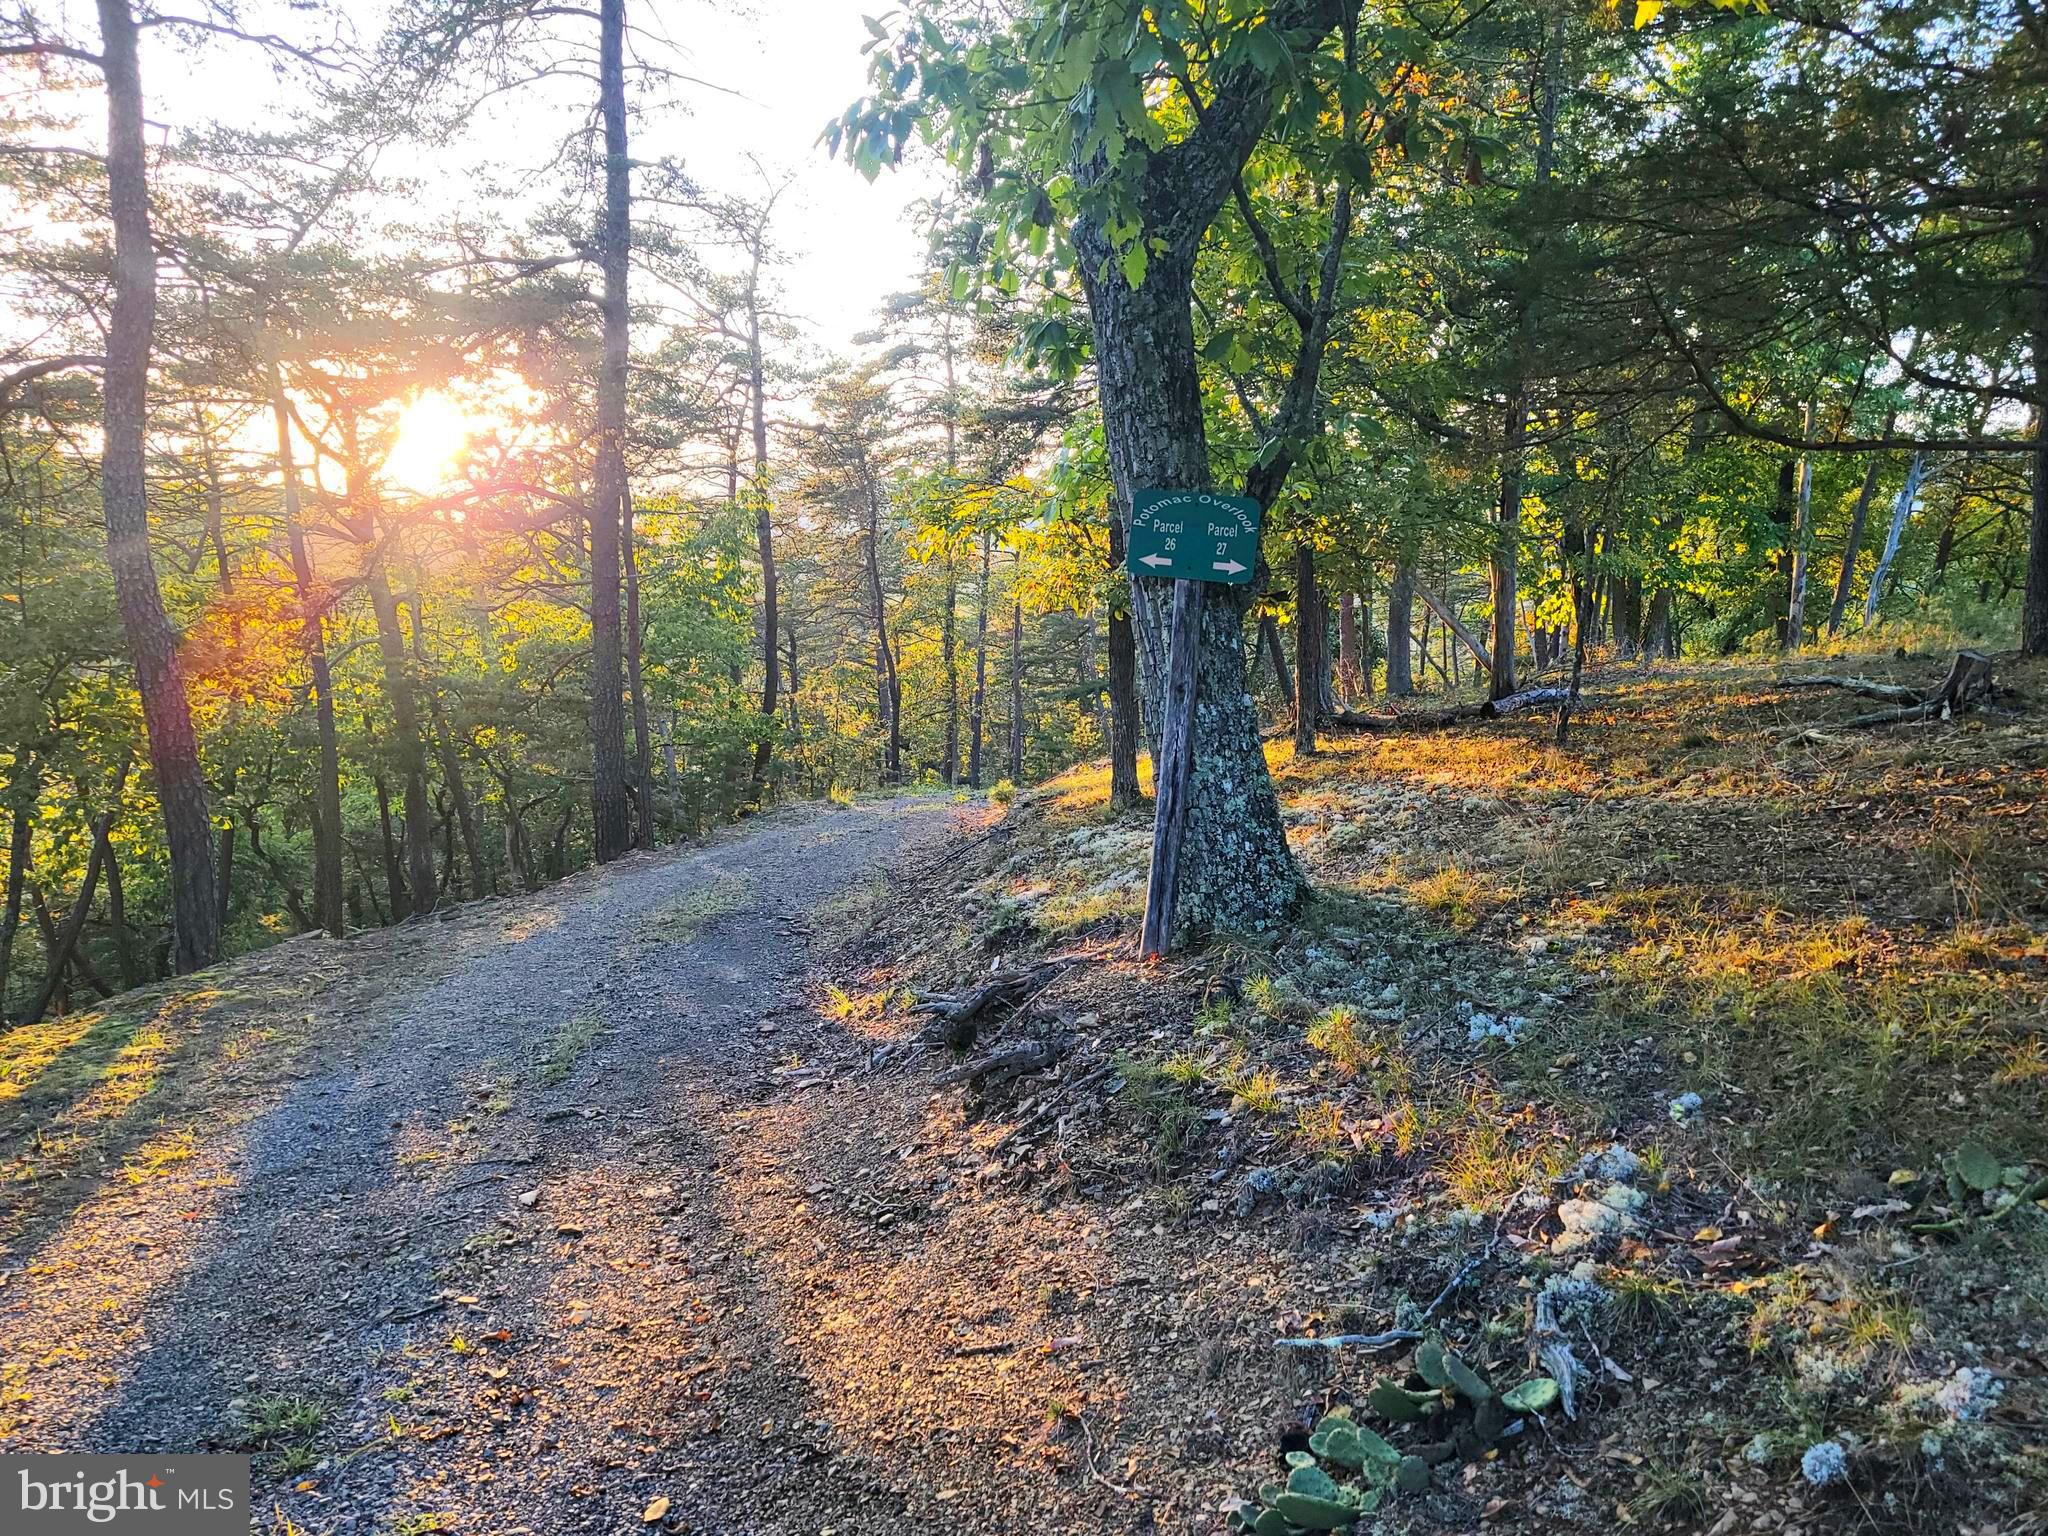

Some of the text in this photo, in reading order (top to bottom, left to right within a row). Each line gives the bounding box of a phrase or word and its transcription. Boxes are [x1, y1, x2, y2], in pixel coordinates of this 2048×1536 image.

[1133, 495, 1258, 534] Potomac Overlook
[1153, 519, 1184, 534] Parcel
[1207, 522, 1238, 538] Parcel
[1164, 537, 1176, 551] 26
[1216, 542, 1227, 556] 27
